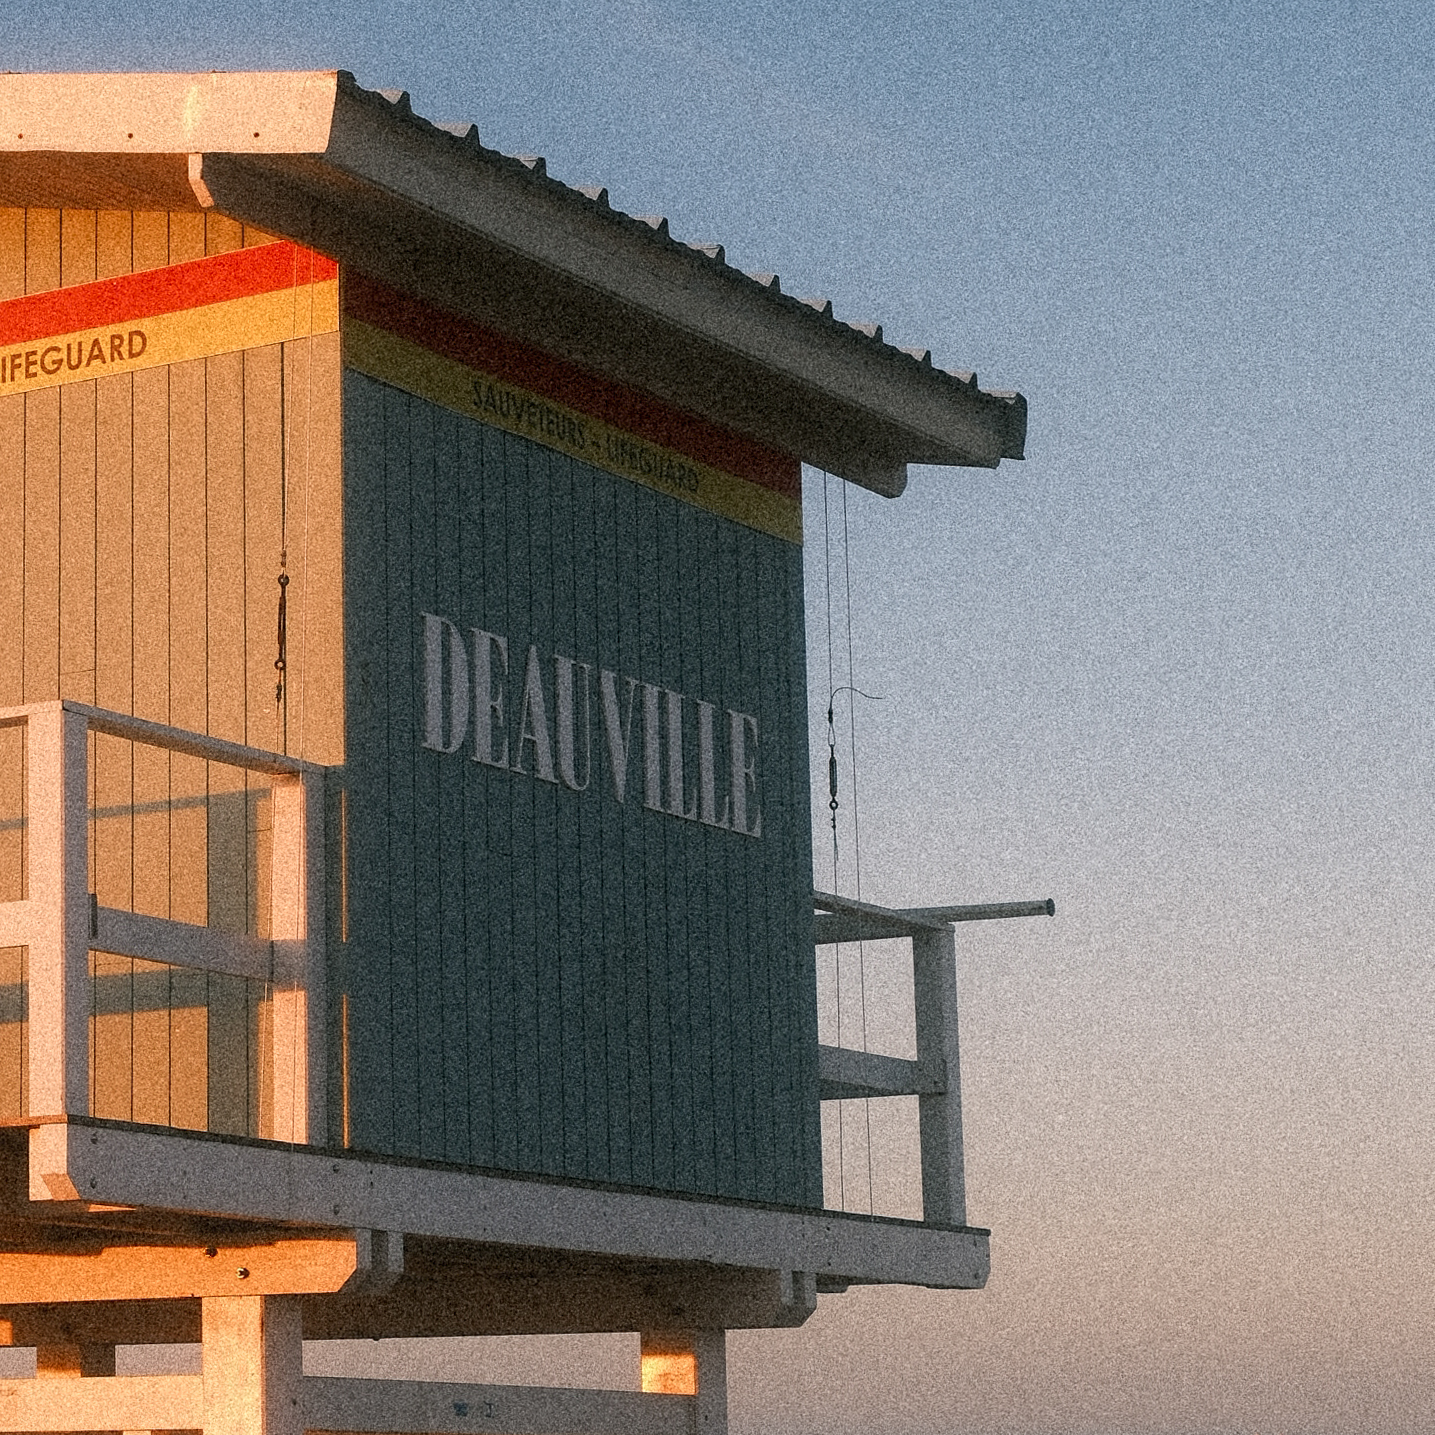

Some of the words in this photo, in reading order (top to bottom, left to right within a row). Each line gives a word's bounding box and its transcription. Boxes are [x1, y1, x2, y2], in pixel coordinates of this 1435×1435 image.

[472, 380, 586, 450] SAUVETEURS
[606, 433, 700, 493] LIFEGUARD
[421, 612, 761, 838] DEAUVILLE
